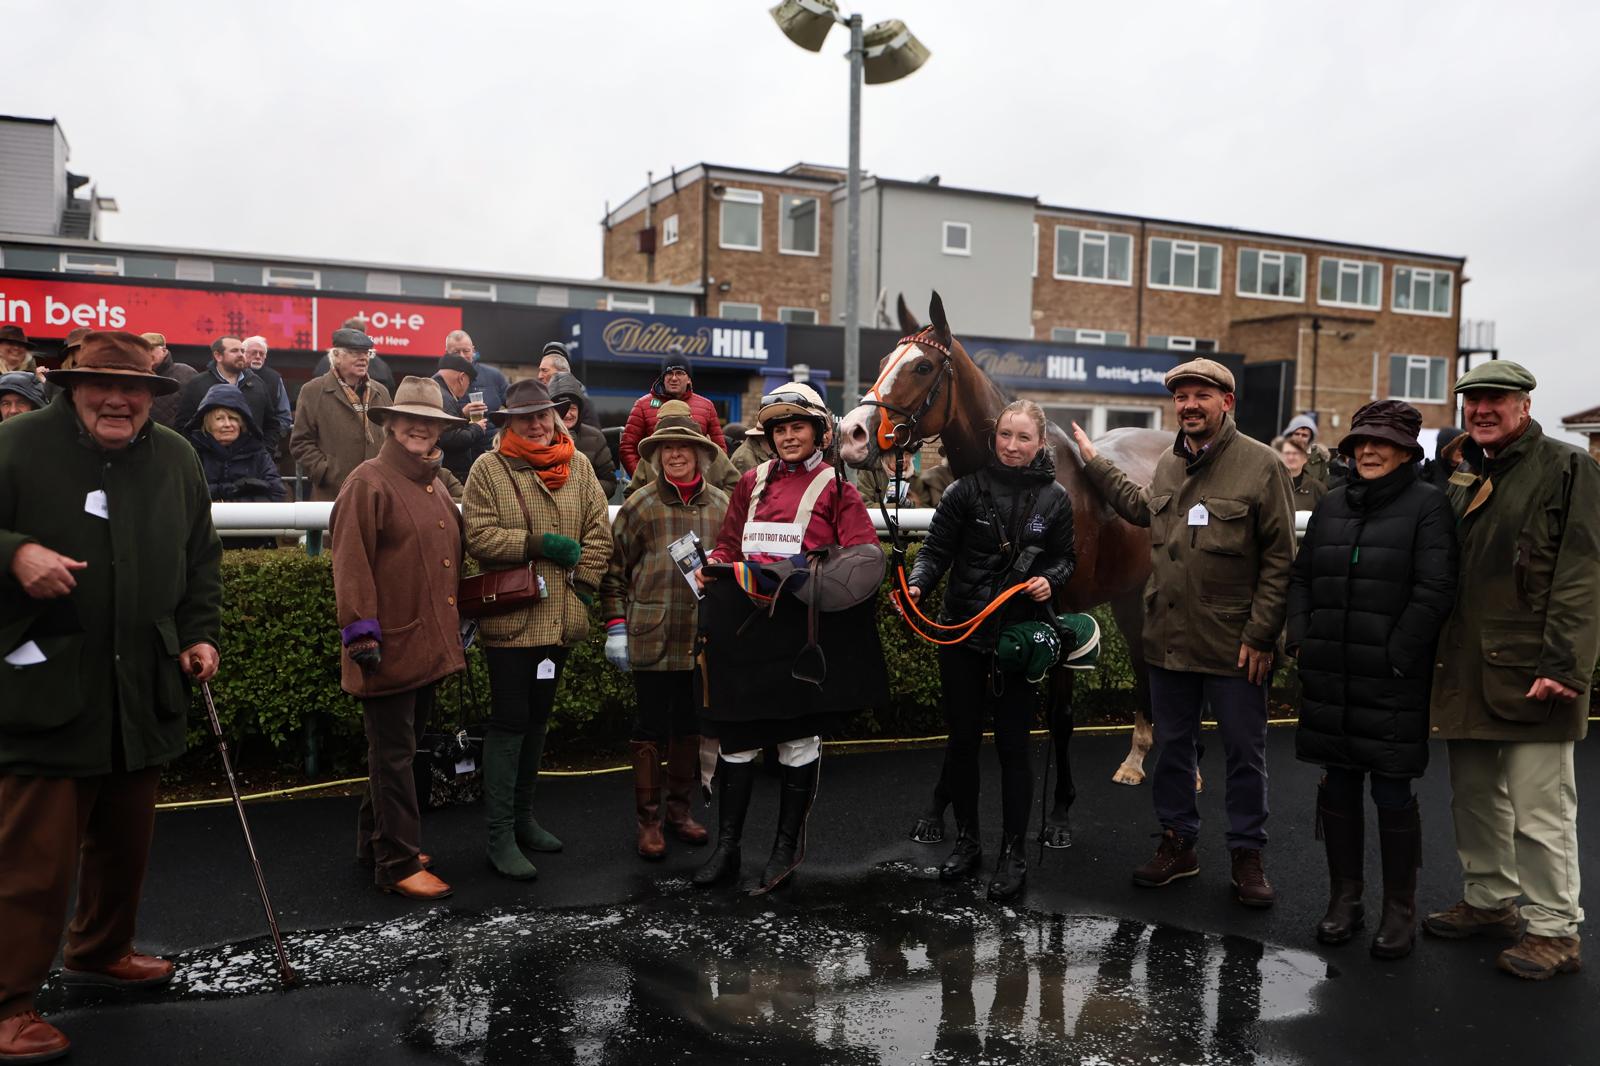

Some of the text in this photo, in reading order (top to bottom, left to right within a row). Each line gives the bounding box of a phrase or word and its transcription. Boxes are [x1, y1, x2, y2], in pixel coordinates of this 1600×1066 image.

[45, 296, 126, 328] bets
[602, 317, 769, 360] William HILL
[1046, 355, 1088, 381] HILL
[1096, 365, 1140, 384] Betting
[758, 532, 765, 541] TO
[765, 533, 778, 542] TROT
[779, 534, 801, 544] RACING
